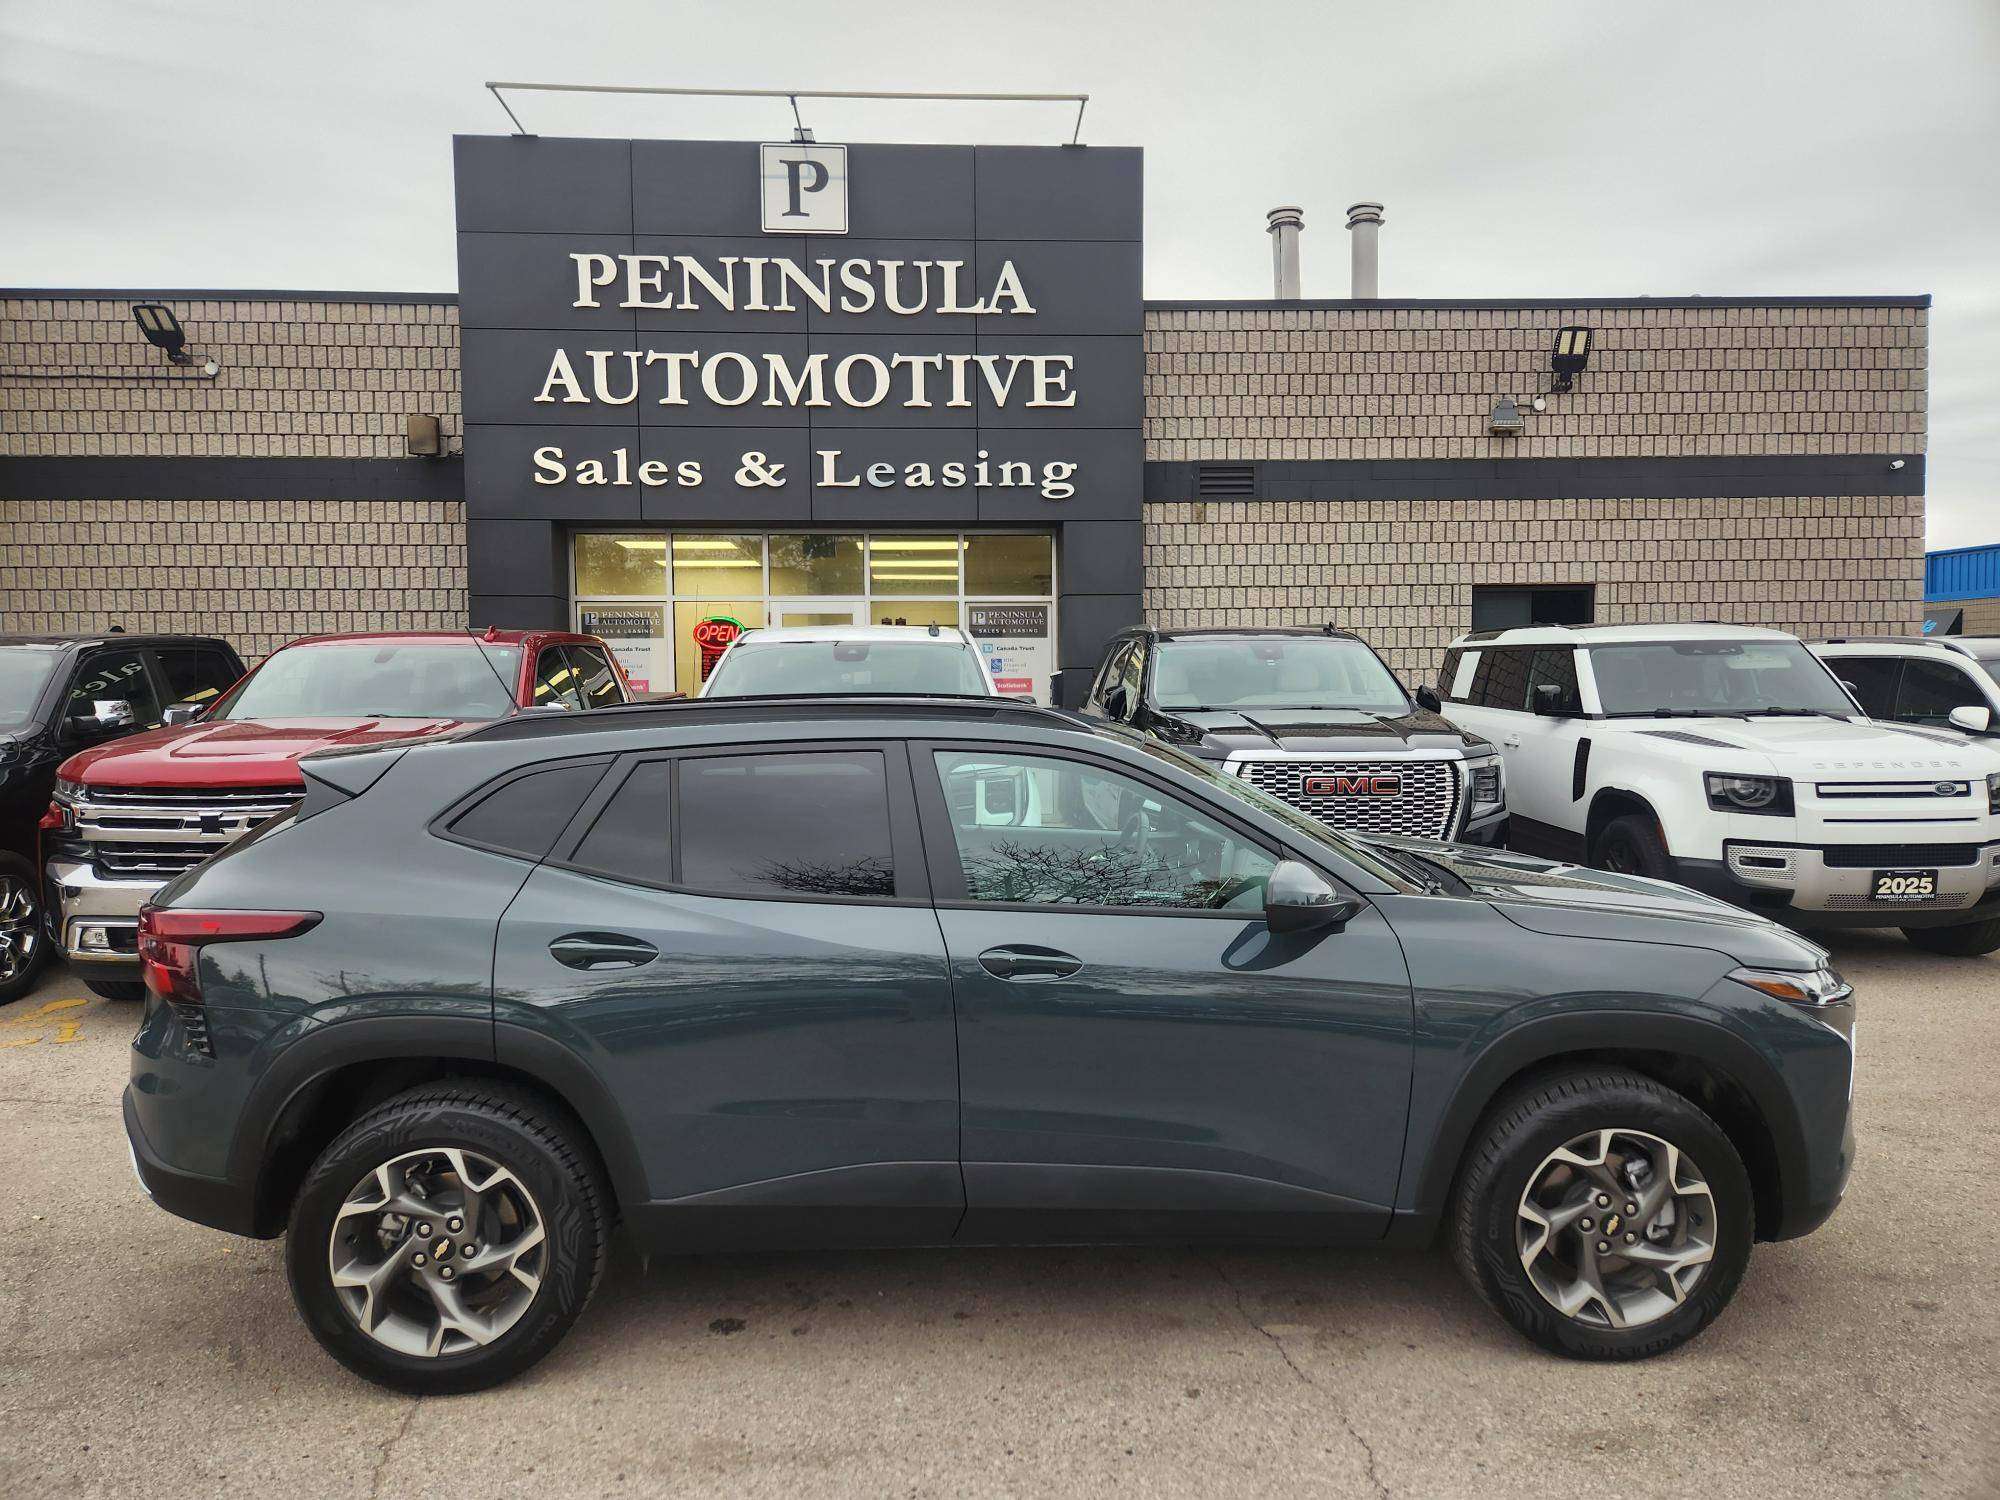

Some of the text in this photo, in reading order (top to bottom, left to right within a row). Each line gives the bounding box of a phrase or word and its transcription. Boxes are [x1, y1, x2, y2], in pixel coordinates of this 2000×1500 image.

[779, 159, 829, 217] P
[569, 252, 1037, 316] PENINSULA
[533, 348, 1077, 408] AUTOMOTIVE
[533, 446, 1078, 499] Sales & Leasing
[601, 618, 661, 626] AUTOMOTIVE
[602, 611, 660, 619] PENINSULA
[988, 611, 1044, 619] PENINSULA
[988, 618, 1045, 626] AUTOMOTIVE
[697, 625, 740, 642] OPEN
[1811, 760, 1962, 770] DEFENDER
[1305, 777, 1399, 795] GMC
[1876, 877, 1934, 895] 2025
